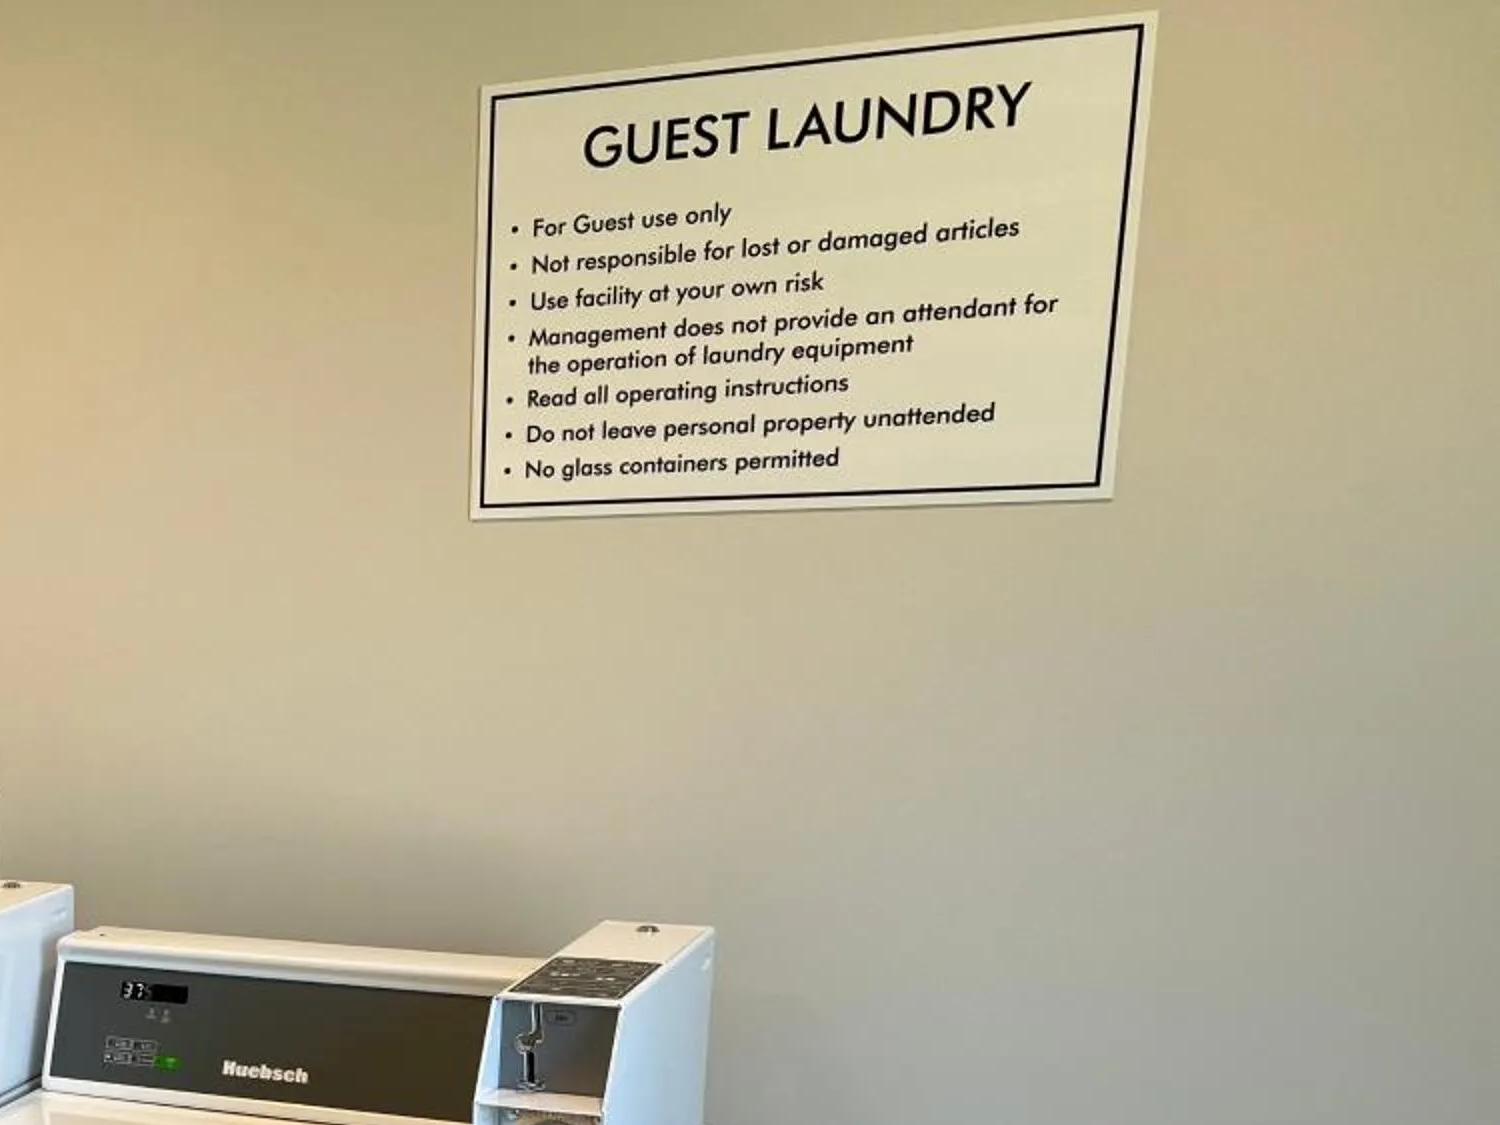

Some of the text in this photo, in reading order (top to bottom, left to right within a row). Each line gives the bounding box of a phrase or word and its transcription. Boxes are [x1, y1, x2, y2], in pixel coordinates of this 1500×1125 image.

[584, 81, 1032, 168] GUEST LAUNDRY
[534, 202, 732, 237] For Guest use only
[532, 217, 1019, 274] Not responsible for lost or damaged articles
[532, 270, 824, 310] Use facility at your own risk
[528, 293, 1058, 348] Management does not provide an attendant for
[528, 335, 914, 376] the operation of laundry equipment
[528, 374, 848, 408] Read all operating instructions
[527, 402, 996, 443] Do not leave personal property unattended
[526, 446, 839, 482] No glass containers permitted
[222, 1060, 308, 1084] Huebsch
